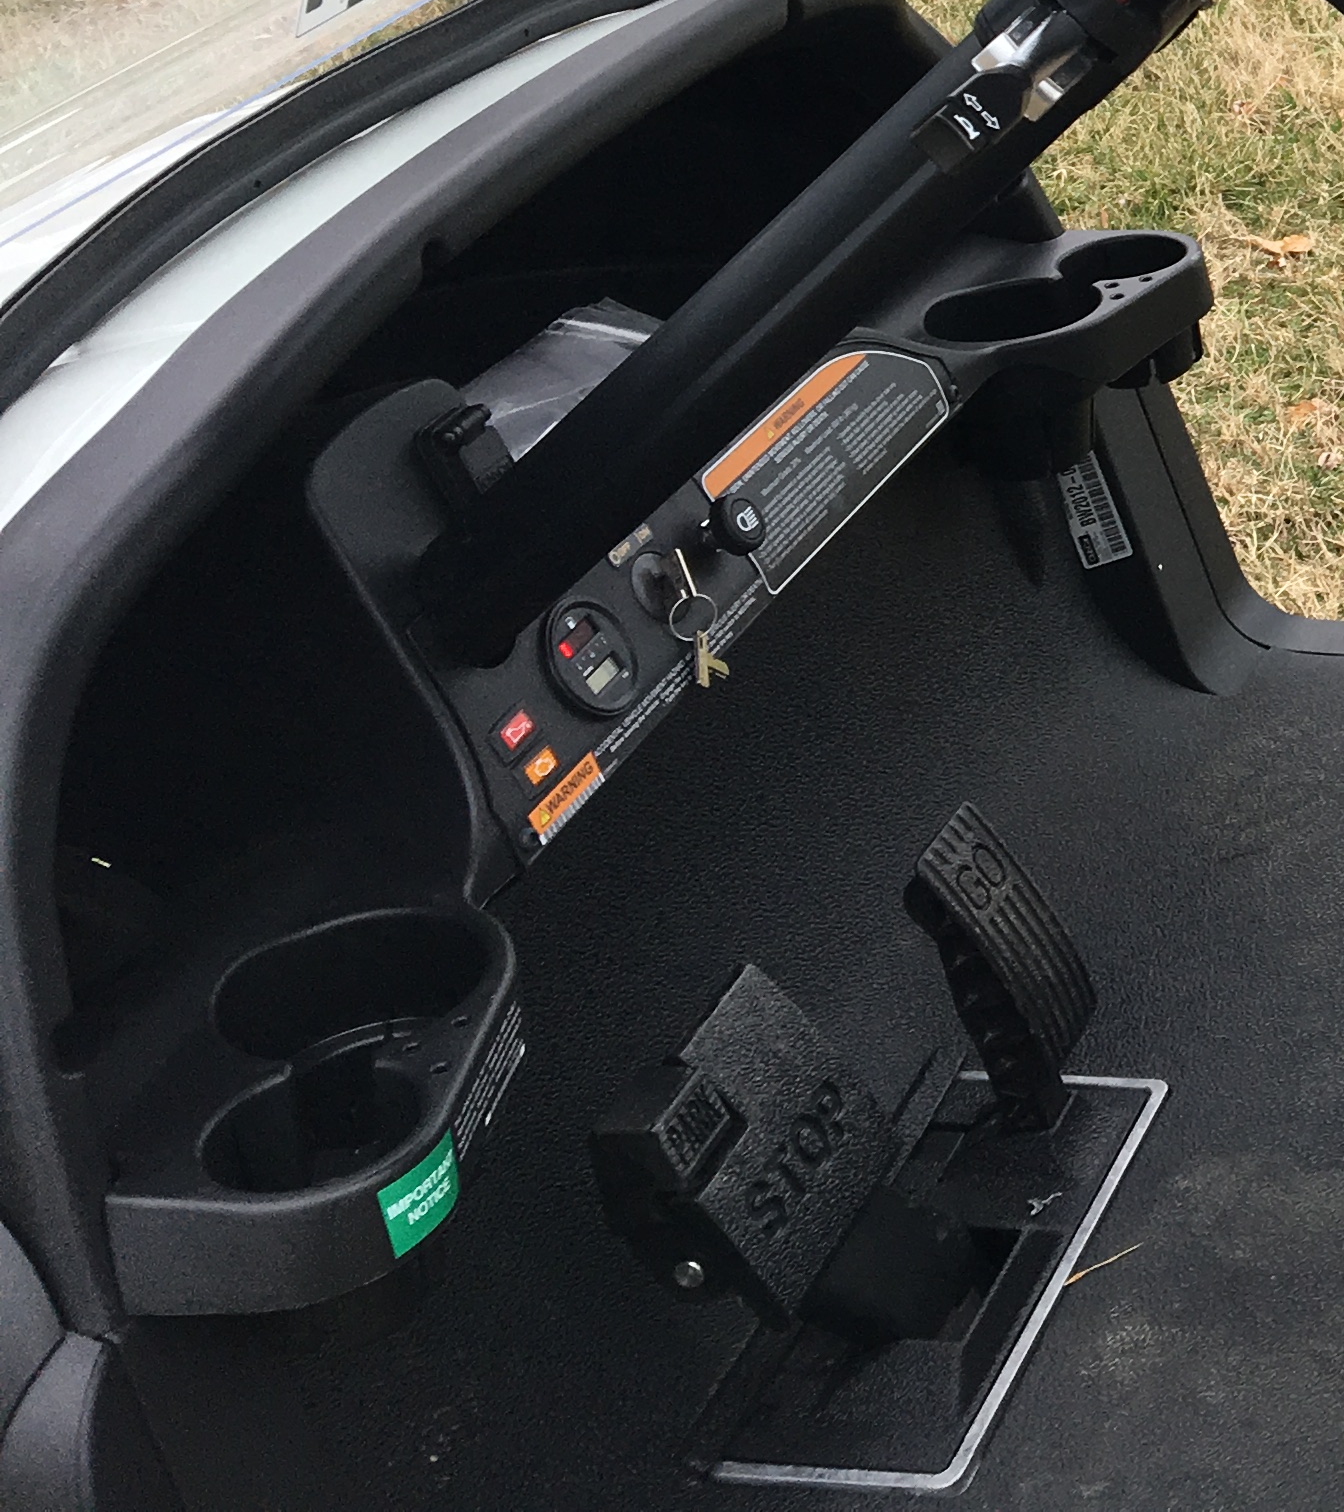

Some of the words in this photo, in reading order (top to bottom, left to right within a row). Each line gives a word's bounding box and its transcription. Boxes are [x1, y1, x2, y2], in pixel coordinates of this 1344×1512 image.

[549, 760, 595, 814] WARNING
[957, 843, 1006, 910] GO
[666, 1086, 725, 1166] PARK
[747, 1080, 844, 1232] STOP
[407, 1175, 452, 1226] NOTICE
